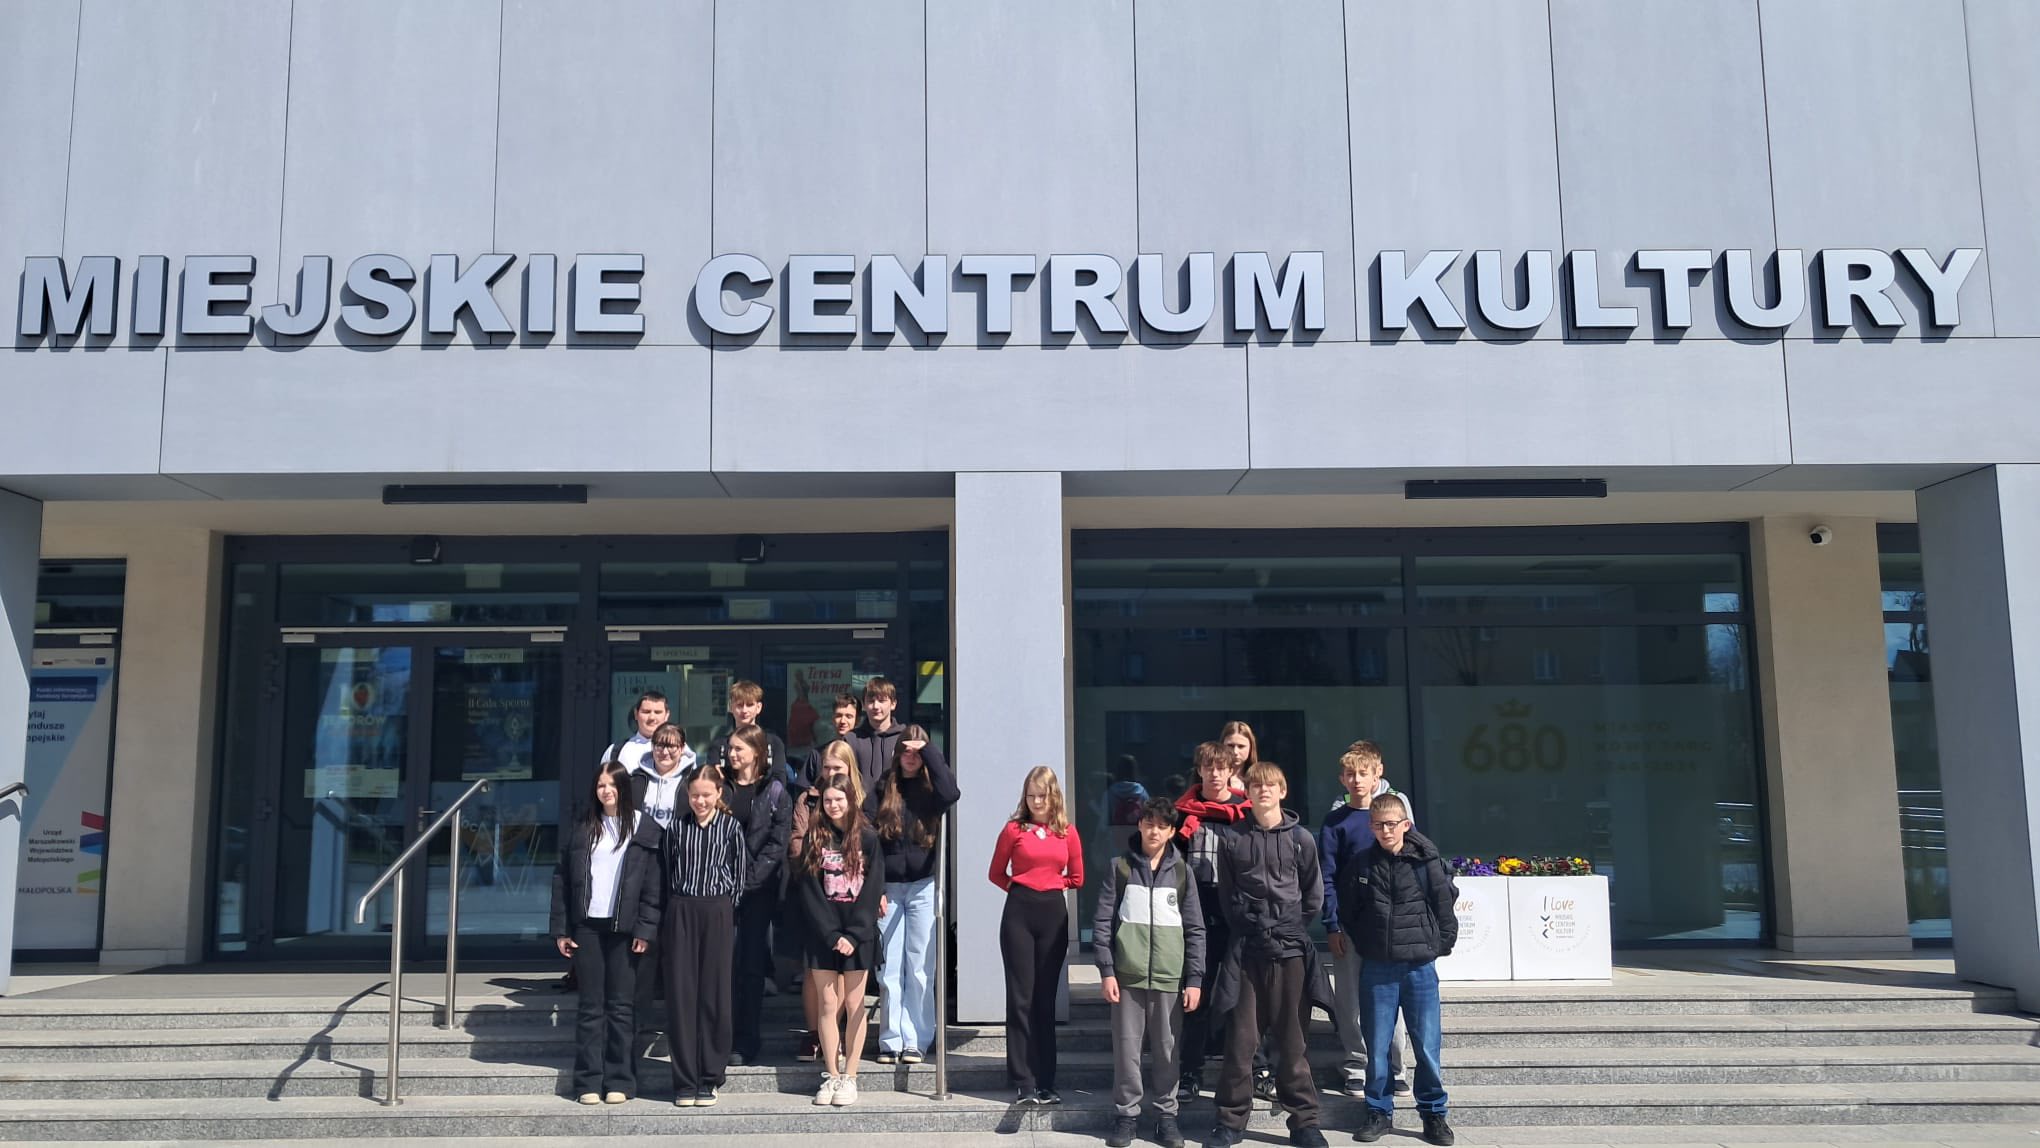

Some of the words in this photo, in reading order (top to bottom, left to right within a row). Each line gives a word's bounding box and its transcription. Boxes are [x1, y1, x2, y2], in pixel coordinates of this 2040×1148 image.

[19, 253, 646, 337] MIEJSKIE
[694, 250, 1326, 336] CENTRUM
[1376, 247, 1984, 332] KULTURY
[808, 666, 842, 680] Teresa
[810, 681, 851, 694] Werner
[1461, 722, 1568, 773] 680
[1455, 901, 1474, 911] ove
